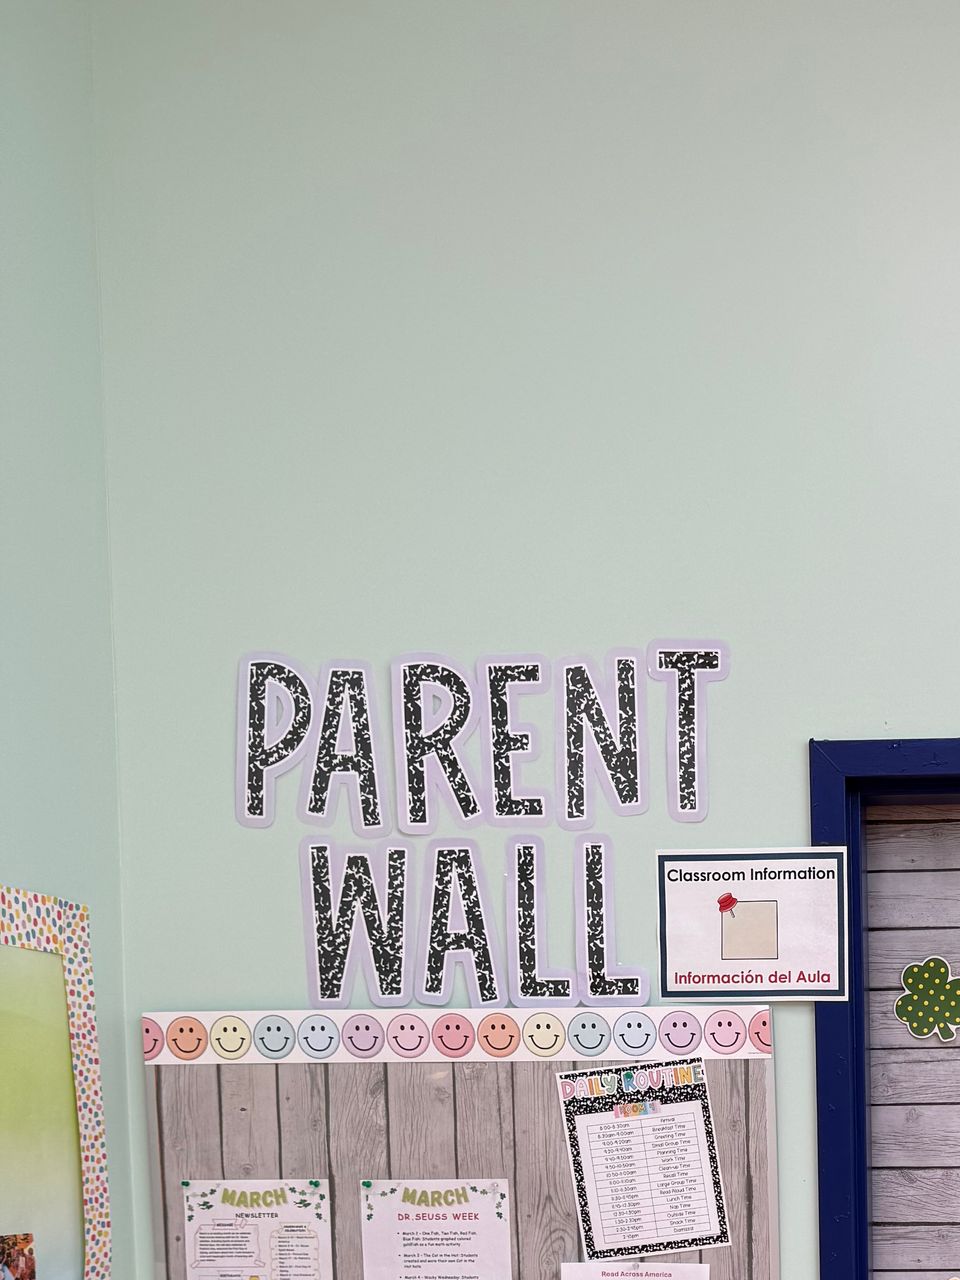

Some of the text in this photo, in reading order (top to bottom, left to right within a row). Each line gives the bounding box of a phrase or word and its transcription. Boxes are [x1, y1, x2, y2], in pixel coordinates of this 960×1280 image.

[245, 651, 721, 827] PARENT
[667, 867, 835, 882] Classroom Information
[309, 843, 641, 1003] WALL
[675, 970, 831, 984] Información del Aula
[562, 1065, 703, 1099] DAILY ROUTINE
[221, 1187, 288, 1208] MARCH
[402, 1186, 469, 1207] MARCH
